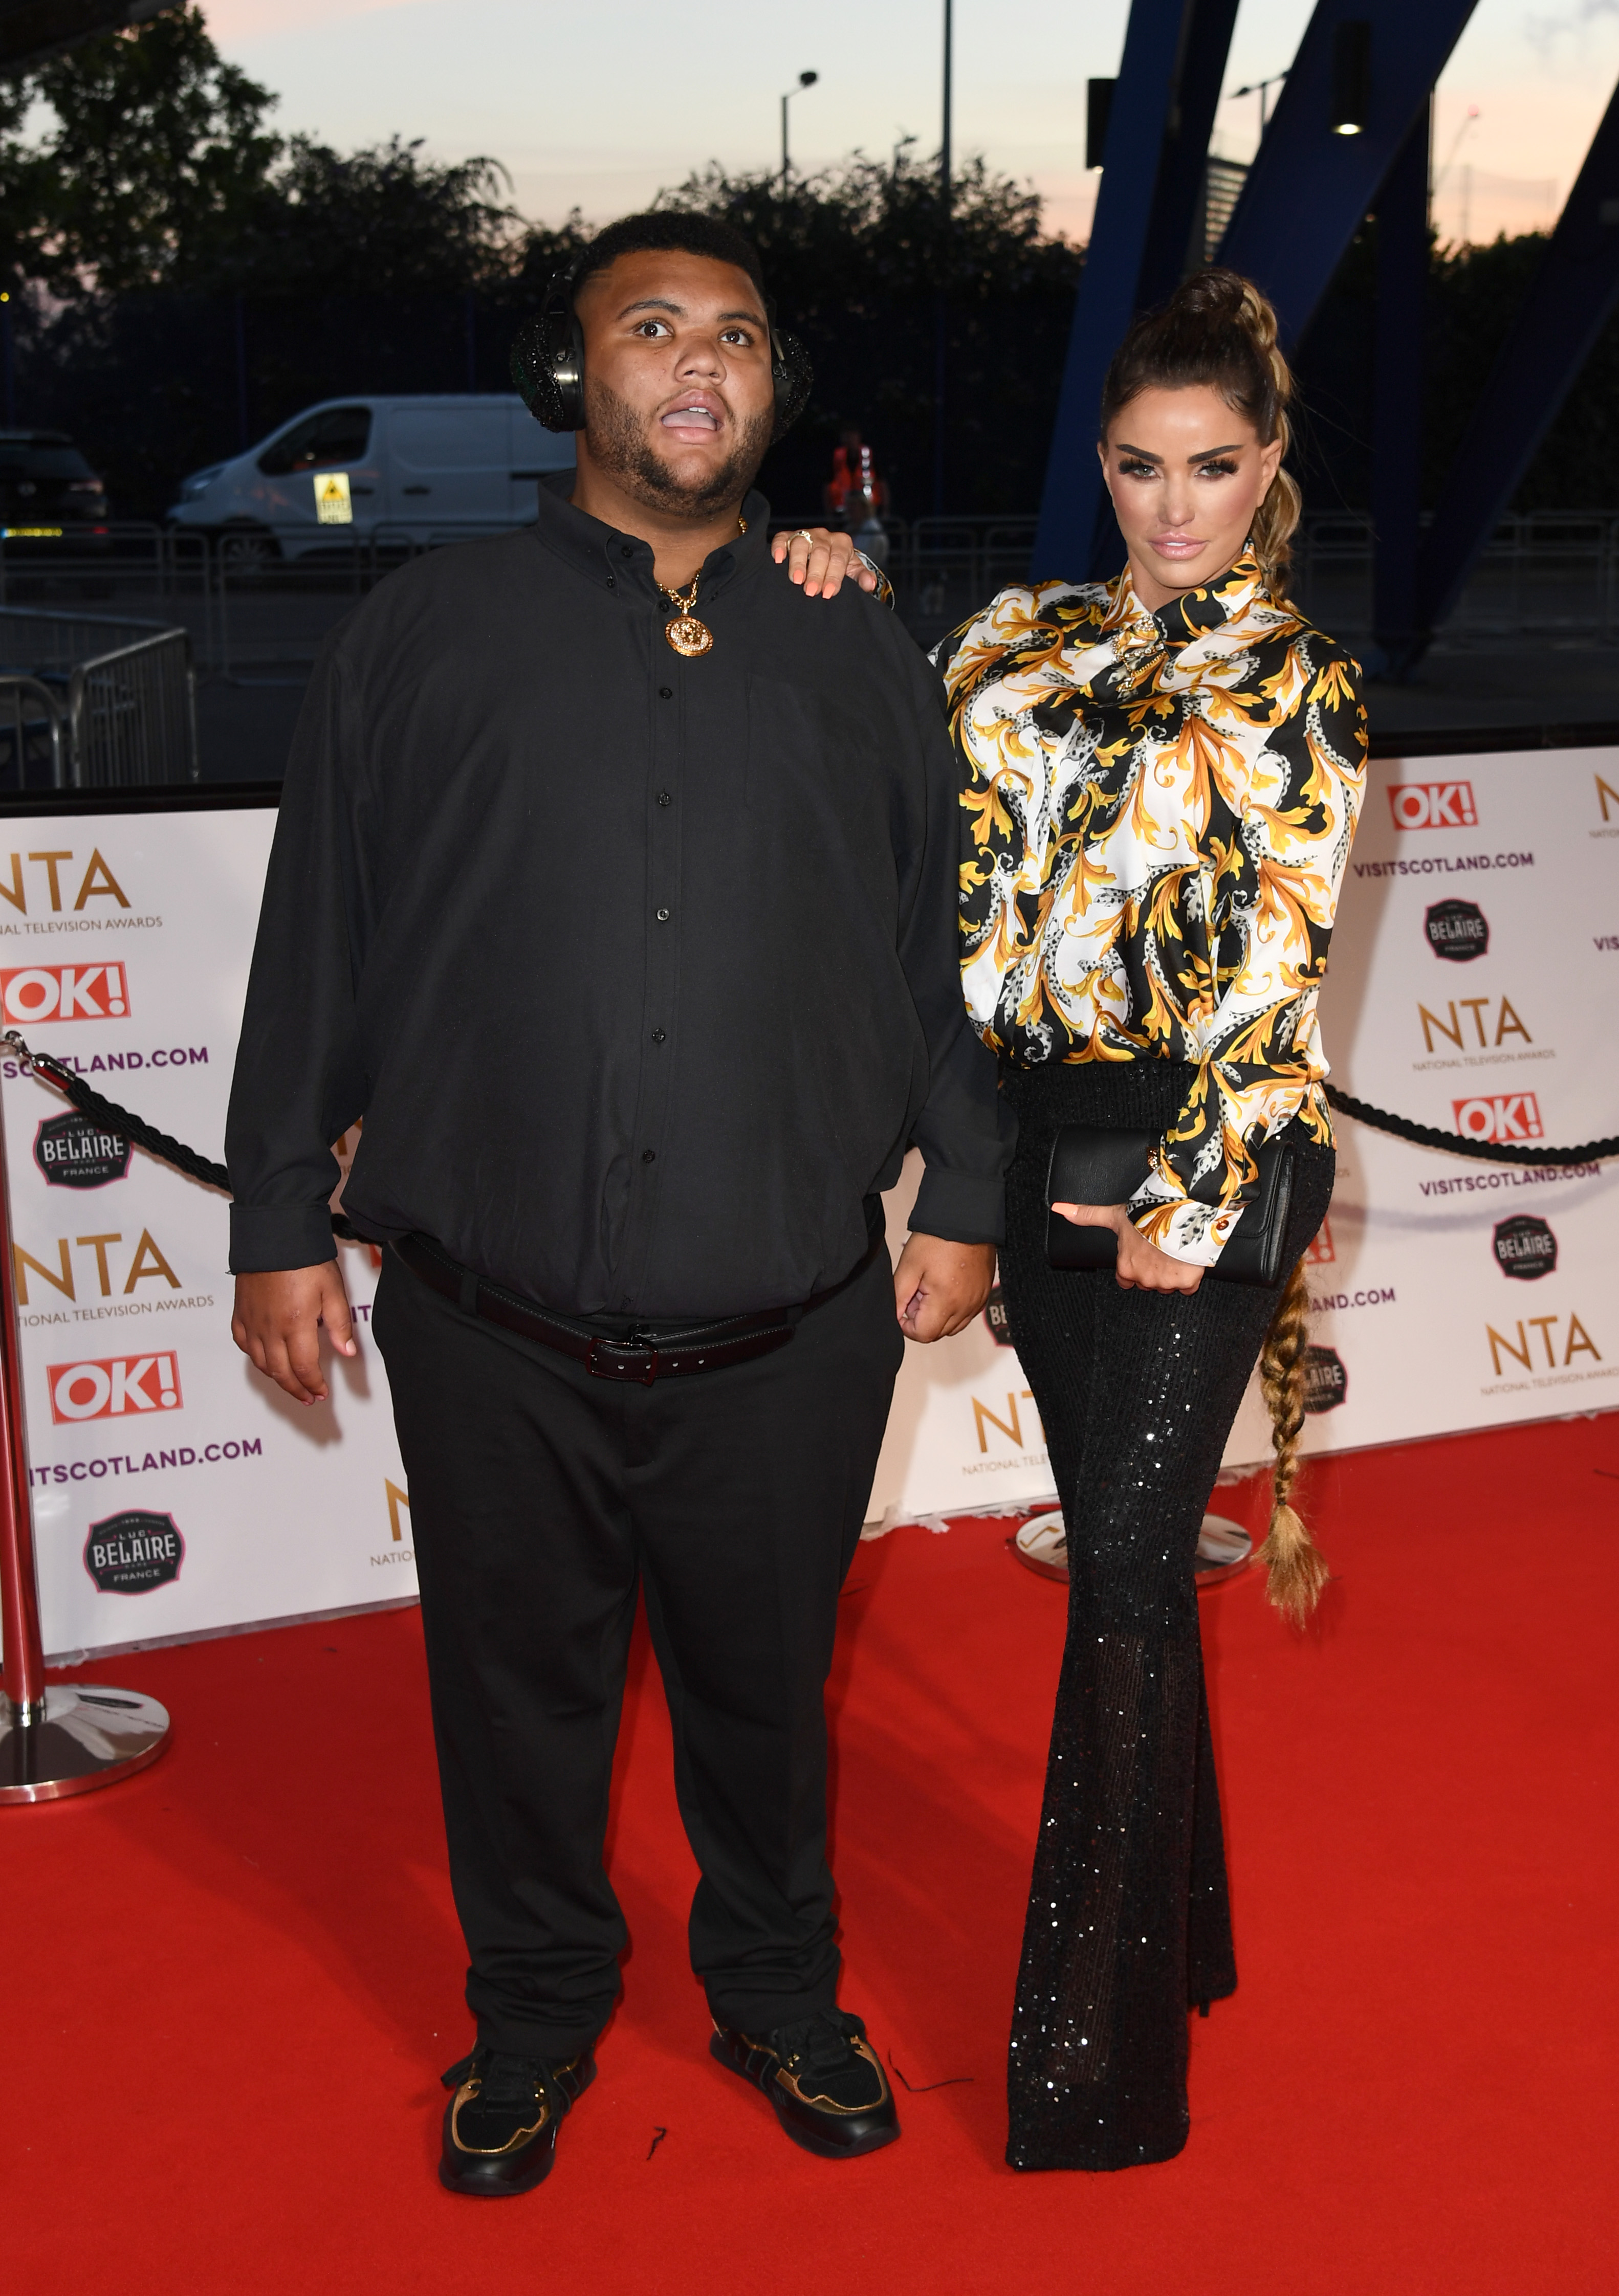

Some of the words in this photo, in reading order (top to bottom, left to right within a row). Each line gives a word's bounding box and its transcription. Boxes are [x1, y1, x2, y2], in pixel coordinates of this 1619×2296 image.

[1393, 784, 1474, 829] OK!
[1352, 853, 1534, 878] VISITSCOTLAND.COM
[24, 920, 101, 934] TELEVISION
[105, 916, 163, 929] AWARDS
[1429, 919, 1484, 941] BELAIRE
[5, 965, 125, 1022] OK!
[1417, 995, 1533, 1053] NTA
[1459, 1095, 1540, 1142] OK!
[42, 1134, 124, 1162] BELAIRE
[63, 1165, 109, 1177] FRANCE
[1419, 1162, 1602, 1197] VISITSCOTLAND.COM
[1497, 1233, 1553, 1259] BELAIRE
[13, 1227, 182, 1306] NTA
[73, 1302, 152, 1321] TELEVISION
[156, 1295, 214, 1312] AWARDS
[1485, 1311, 1602, 1376] NTA
[55, 1355, 178, 1420] OK!
[92, 1534, 176, 1568] BELAIRE
[113, 1568, 161, 1582] FRANCE
